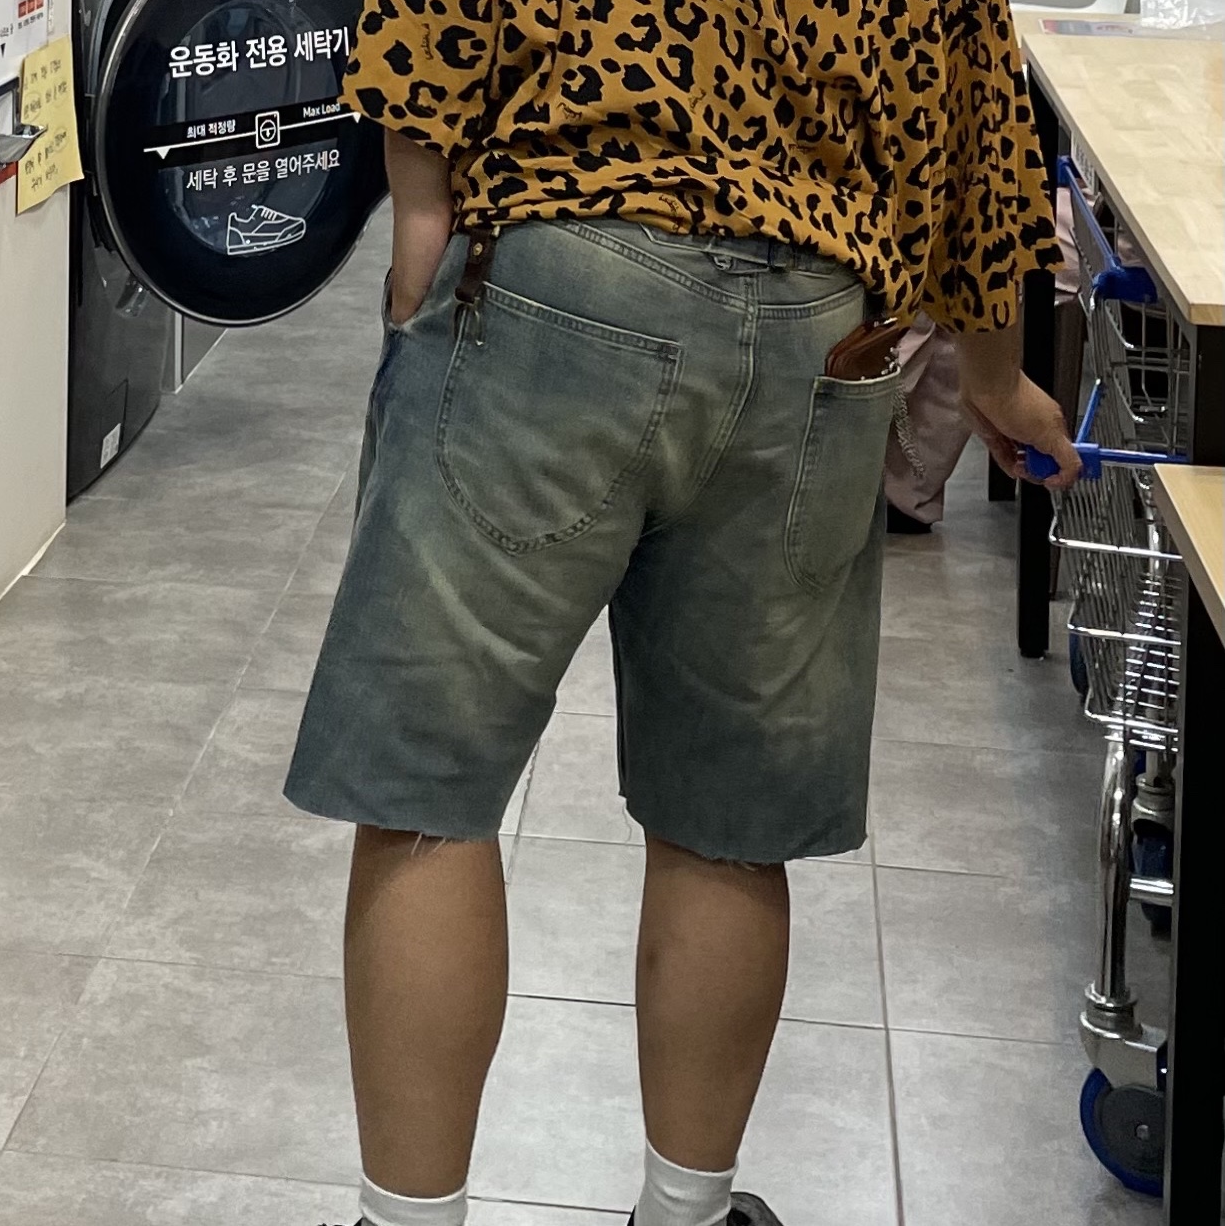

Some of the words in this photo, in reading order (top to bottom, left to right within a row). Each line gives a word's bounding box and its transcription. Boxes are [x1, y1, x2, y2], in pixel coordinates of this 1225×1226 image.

[168, 40, 239, 78] 운동화
[245, 34, 288, 70] 전용
[293, 26, 351, 62] 세탁기
[186, 124, 207, 139] 최대
[208, 119, 237, 136] 적정량
[303, 107, 321, 118] Max
[322, 101, 341, 116] Load
[186, 171, 218, 191] 세탁
[221, 165, 238, 187] 후
[241, 159, 271, 183] 문을
[274, 148, 341, 180] 열어주세요
